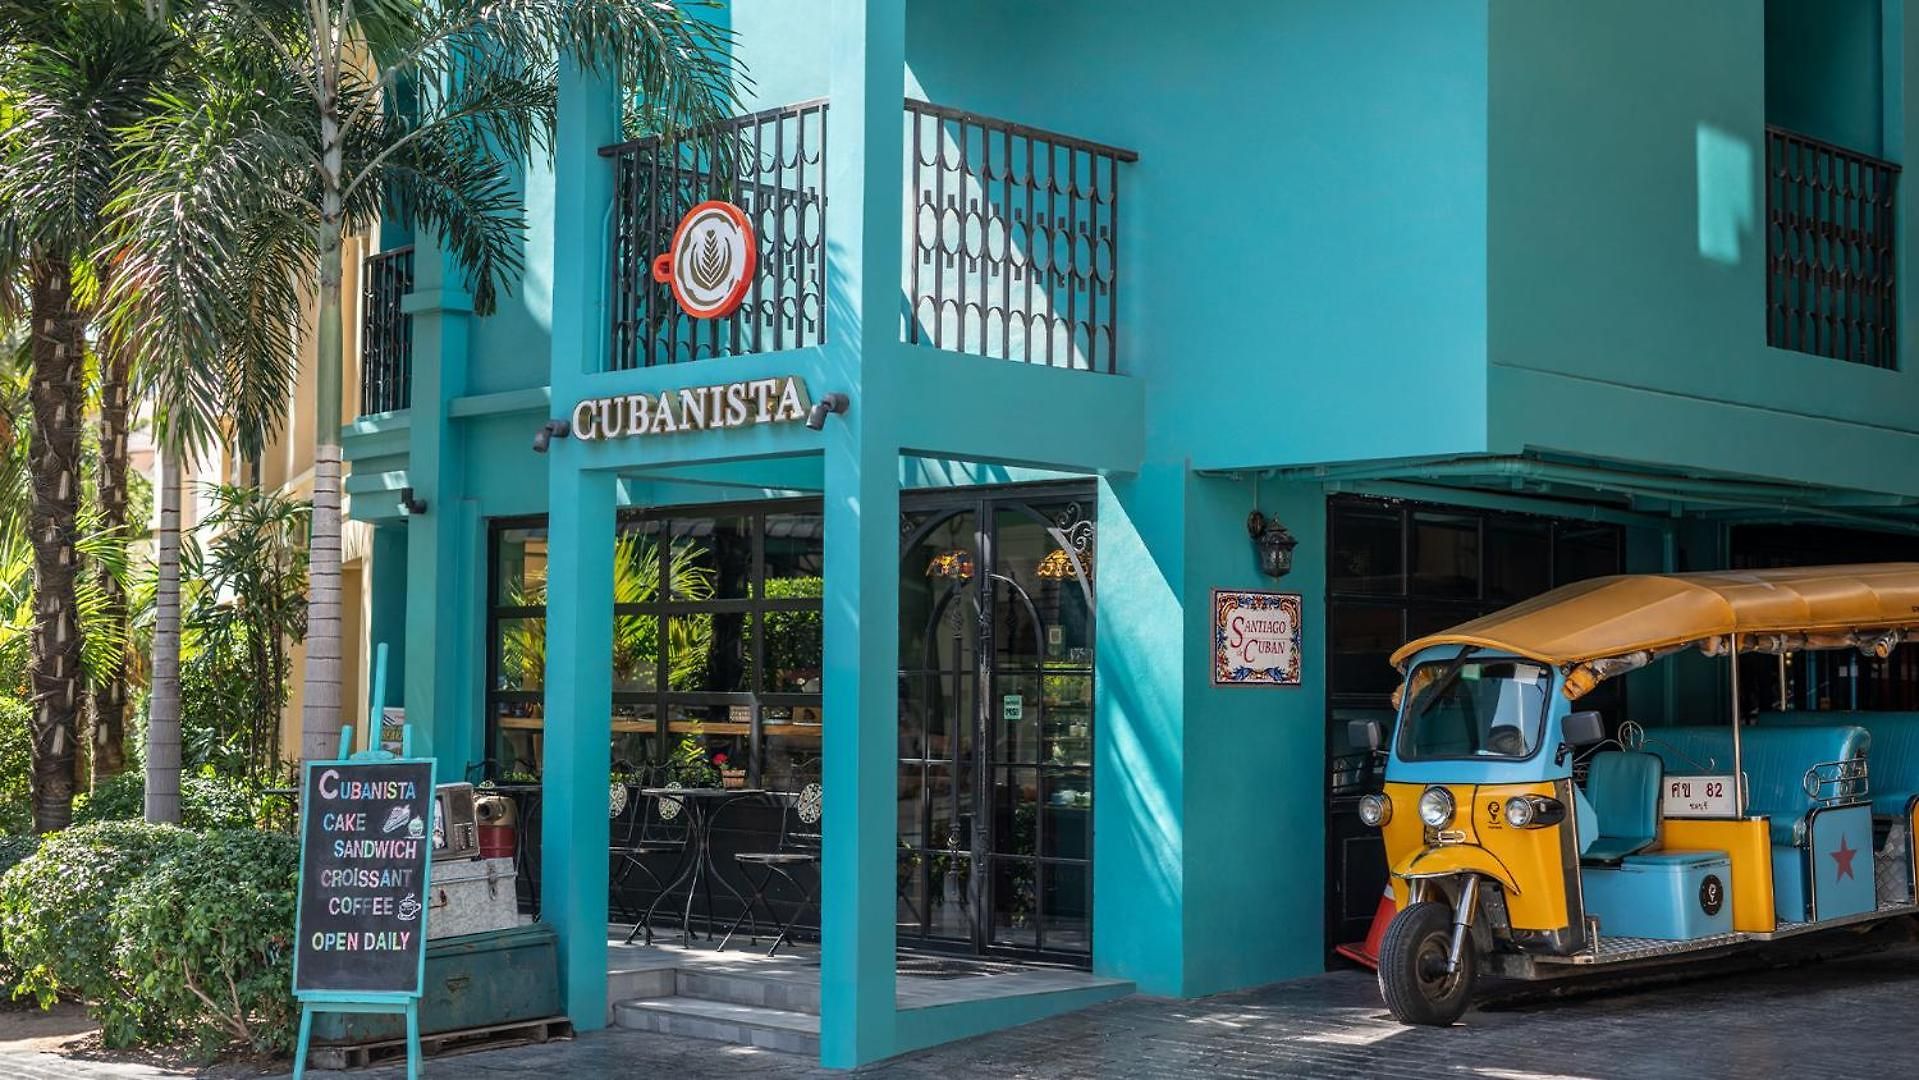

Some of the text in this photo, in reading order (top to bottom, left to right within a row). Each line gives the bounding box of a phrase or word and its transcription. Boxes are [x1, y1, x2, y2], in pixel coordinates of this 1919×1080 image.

[572, 376, 808, 441] CUBANISTA
[1231, 616, 1286, 648] SANTIAGO
[1244, 639, 1285, 663] CUBAN
[318, 769, 416, 800] CUBANISTA
[1706, 782, 1723, 798] 82
[323, 813, 367, 832] CAKE
[334, 839, 417, 859] SANDWICH
[328, 896, 393, 916] COFFEE
[312, 931, 410, 951] OPEN DAILY
